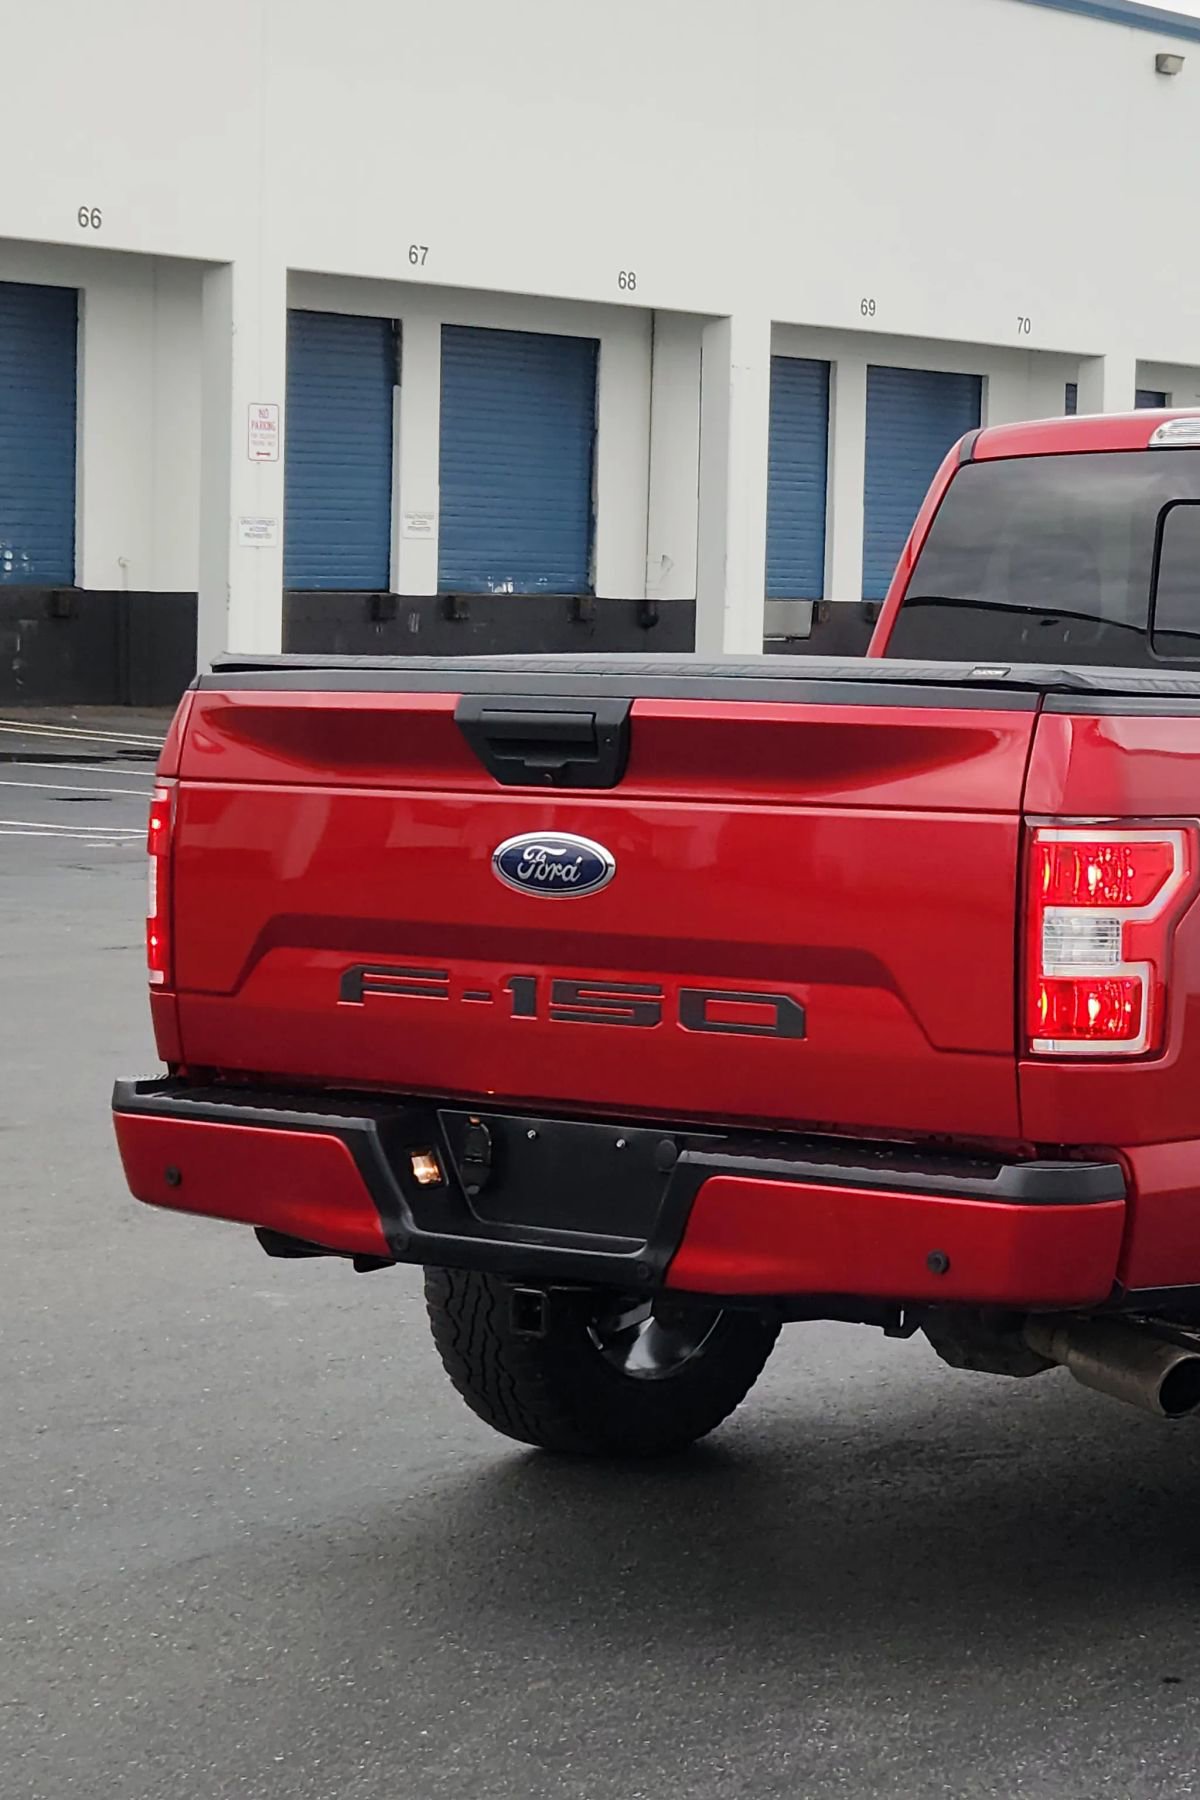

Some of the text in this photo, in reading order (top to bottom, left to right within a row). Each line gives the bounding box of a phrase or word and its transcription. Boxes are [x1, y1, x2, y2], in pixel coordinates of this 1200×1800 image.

[77, 205, 103, 230] 66
[408, 244, 430, 267] 67
[617, 270, 637, 292] 68
[860, 297, 876, 317] 69
[1016, 316, 1031, 335] 70
[258, 408, 270, 419] NO
[250, 420, 277, 431] PARKING
[516, 845, 584, 882] Ford
[337, 963, 808, 1041] F-150
